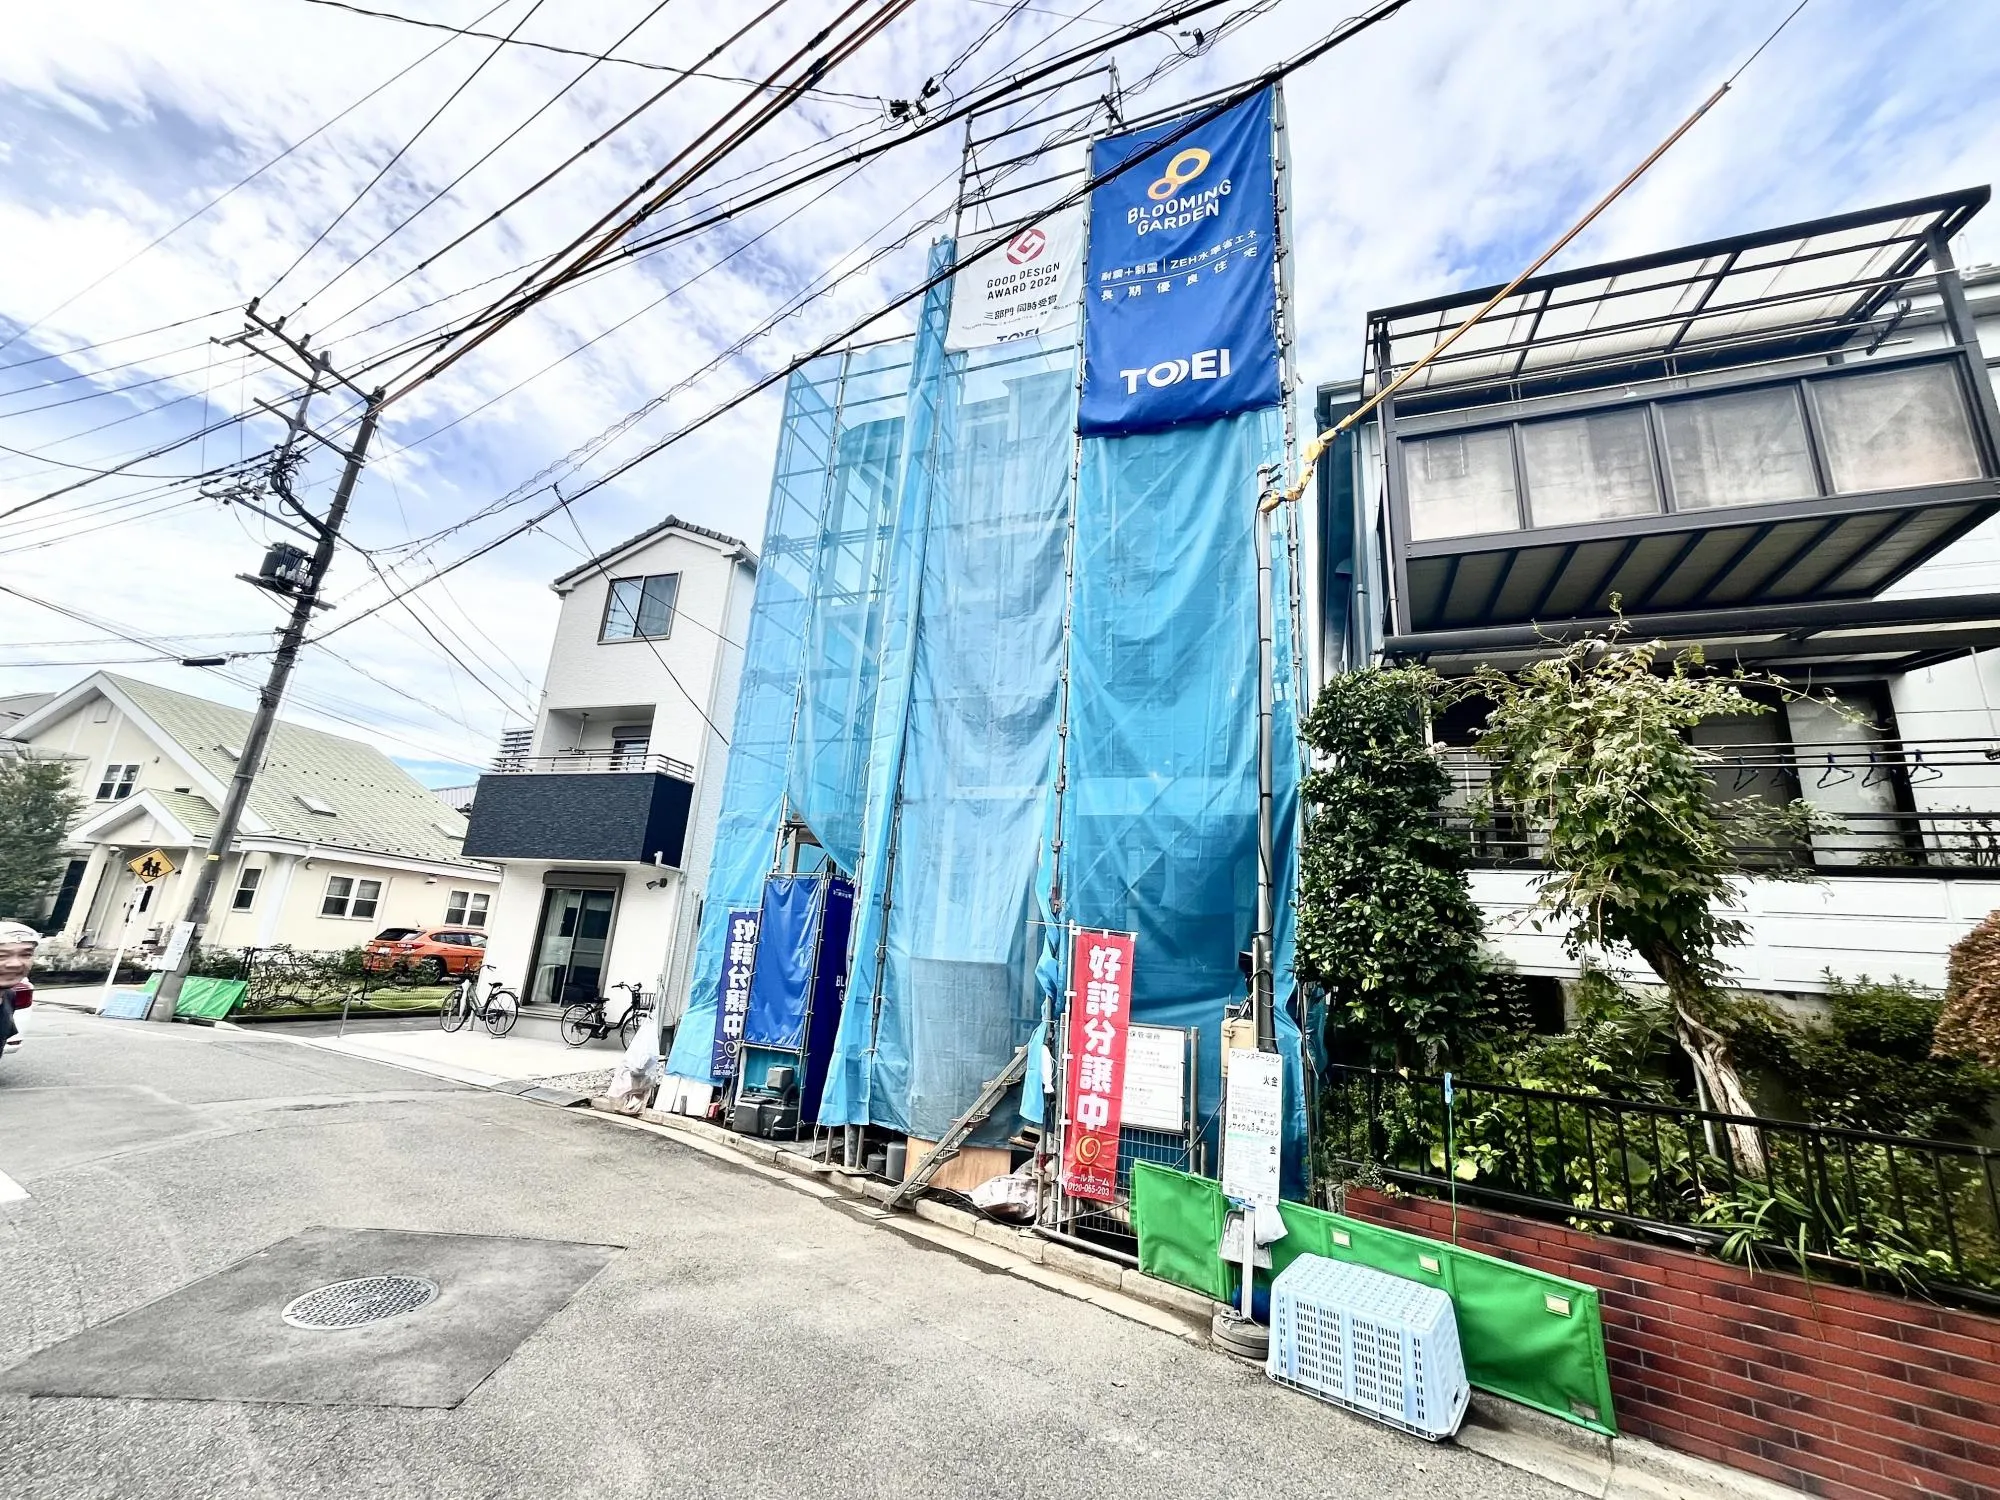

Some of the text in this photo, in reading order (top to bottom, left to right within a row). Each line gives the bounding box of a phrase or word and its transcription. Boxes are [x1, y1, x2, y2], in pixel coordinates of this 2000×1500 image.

[1127, 178, 1232, 225] BLOOMING
[1137, 198, 1219, 236] GARDEN
[987, 261, 1060, 289] GOOD DESIGN
[987, 274, 1058, 300] AWARD 2024
[1119, 348, 1231, 395] TOEI
[1076, 944, 1123, 1131] 好評分譲中
[1231, 1050, 1280, 1064] クリーンステーション
